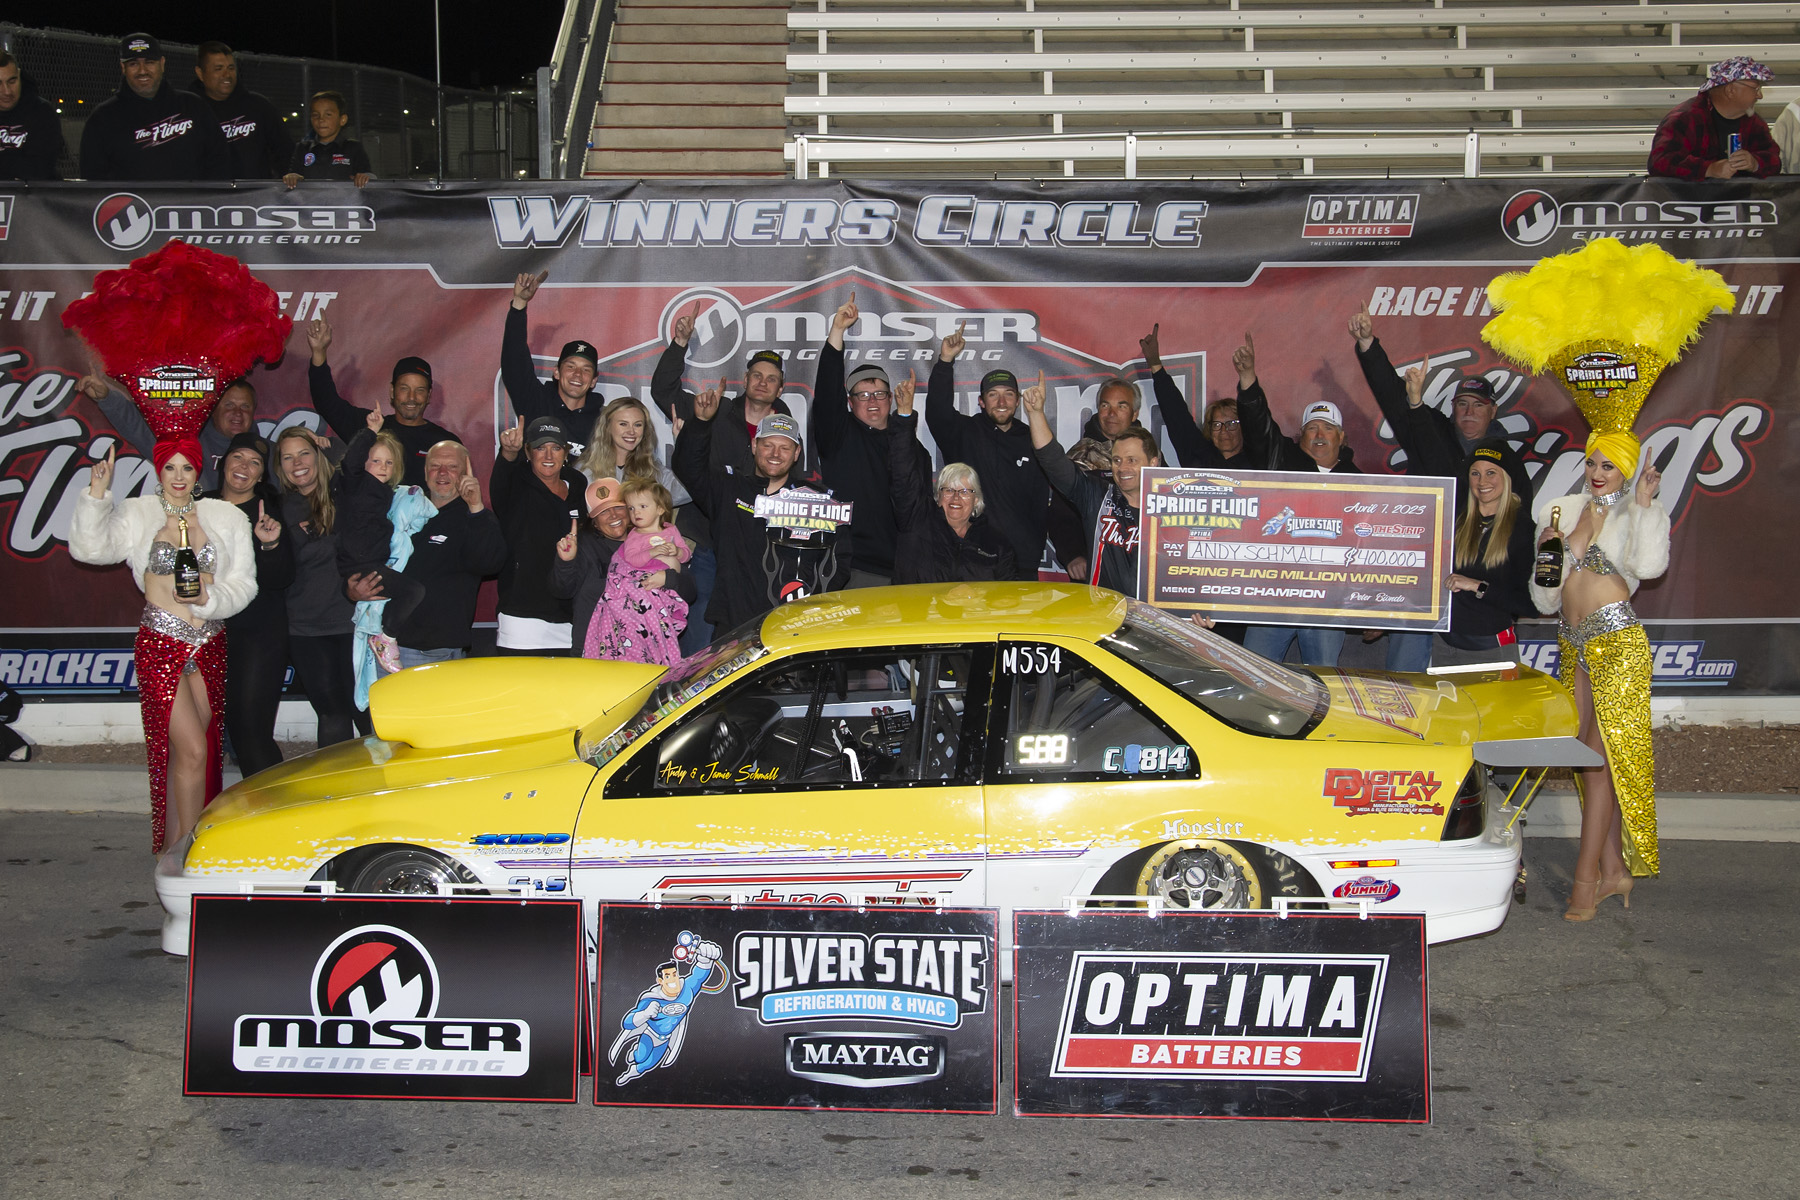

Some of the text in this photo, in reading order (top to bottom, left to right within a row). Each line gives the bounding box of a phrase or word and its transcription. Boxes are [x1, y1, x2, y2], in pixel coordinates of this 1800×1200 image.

[135, 120, 193, 142] The Flings
[154, 205, 377, 232] MOSER
[1310, 199, 1411, 221] OPTIMA
[1559, 200, 1779, 228] MOSER
[487, 194, 1210, 249] WINNERS CIRCLE
[1328, 226, 1391, 236] BATTERIES
[169, 234, 362, 246] ENGINEERING
[1571, 228, 1764, 240] ENGINEERING
[11, 291, 56, 321] IT
[290, 291, 338, 321] IT
[1368, 286, 1463, 316] RACE
[1740, 285, 1784, 315] IT
[745, 312, 1037, 342] MOSER
[139, 378, 214, 390] SPRING FLING
[1566, 365, 1637, 382] SPRING FLING
[149, 390, 204, 398] MILLION
[1166, 474, 1182, 484] RACE
[1194, 472, 1234, 483] EXPERIENCE
[790, 492, 830, 500] MOSER
[1146, 494, 1259, 518] SPRING FLING
[756, 498, 851, 522] SPRING FLING
[1344, 502, 1378, 514] April
[1391, 504, 1426, 515] 2023
[768, 516, 838, 531] MILLION
[1160, 514, 1244, 530] MILLION
[1286, 518, 1317, 532] SILVER
[1317, 518, 1342, 534] STATE
[1373, 526, 1392, 534] THE
[1191, 542, 1241, 560] ANDY
[1244, 545, 1334, 564] SCHMALL
[1168, 566, 1418, 586] SPRING FLING MILLION WINNER
[1200, 585, 1241, 595] 2023
[1243, 586, 1326, 599] CHAMPION
[1350, 592, 1372, 602] Peter
[1002, 646, 1062, 674] M554
[1018, 734, 1068, 764] 588
[660, 760, 780, 785] Andy & Jamie Schmall
[1322, 768, 1442, 797] DIGITAL
[1332, 778, 1441, 808] DELAY
[469, 833, 570, 845] KIDD
[1158, 818, 1244, 840] Hoosier
[739, 936, 982, 1005] SILVER STATE
[773, 994, 946, 1017] REFRIGERATION & HVAC
[1084, 971, 1356, 1028] OPTIMA
[239, 1018, 522, 1052] MOSER
[253, 1056, 506, 1072] ENGINEERING
[802, 1044, 930, 1066] MAYTAG
[1130, 1044, 1302, 1066] BATTERIES
